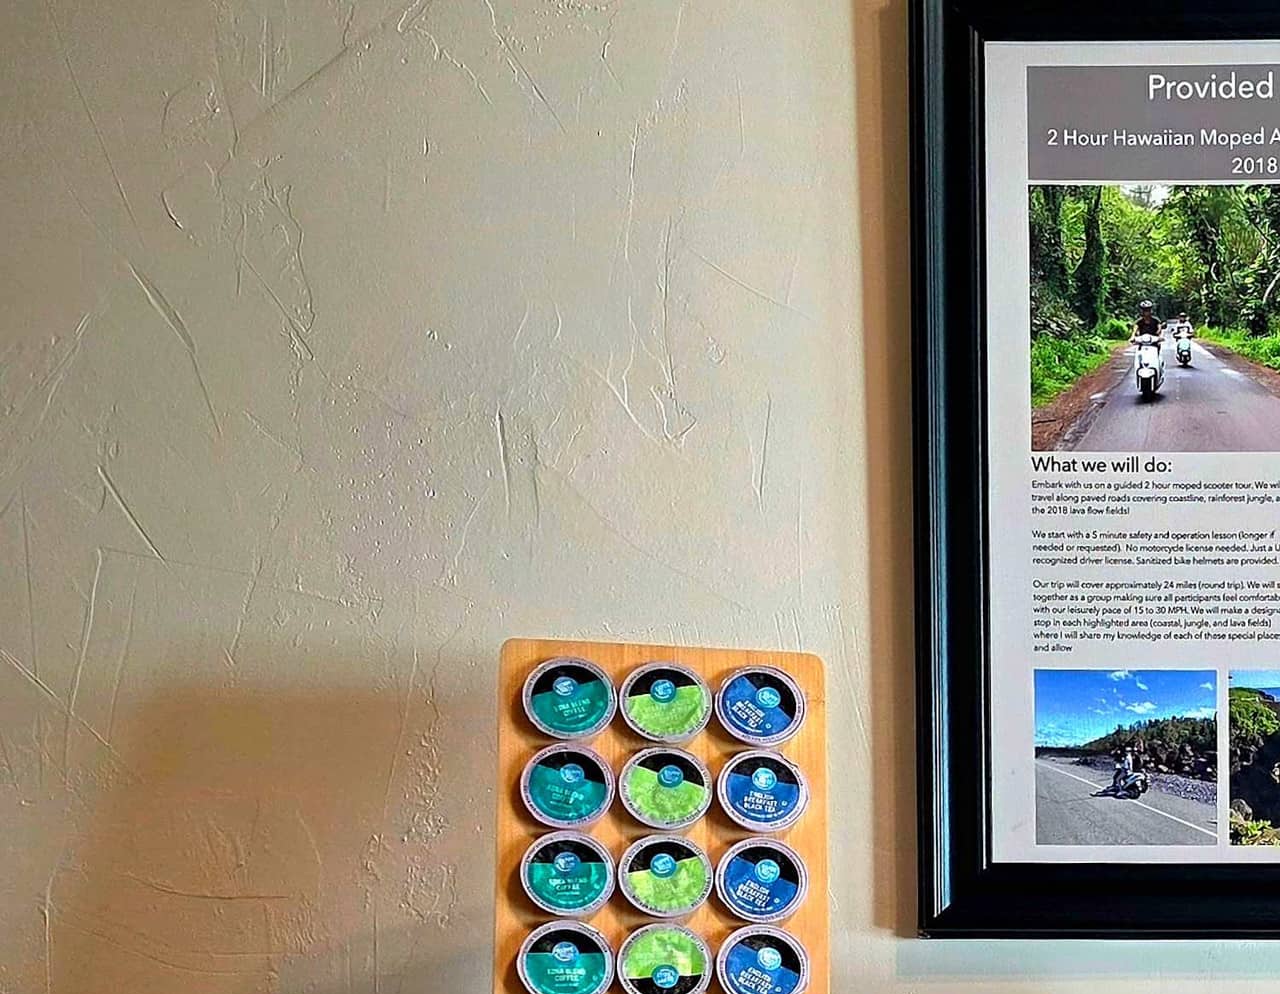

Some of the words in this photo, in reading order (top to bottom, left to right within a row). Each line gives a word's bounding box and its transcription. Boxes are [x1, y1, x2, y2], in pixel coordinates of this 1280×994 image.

[1148, 71, 1273, 100] Provided
[1047, 128, 1058, 146] 2
[1063, 128, 1109, 147] Hour
[1113, 128, 1195, 147] Hawaiian
[1200, 126, 1265, 151] Moped
[1231, 156, 1278, 175] 2018
[1030, 455, 1078, 473] What
[1081, 460, 1107, 473] we
[1110, 455, 1139, 473] will
[1143, 455, 1172, 473] do:
[1031, 480, 1063, 489] Embark
[1064, 480, 1082, 489] with
[1113, 480, 1143, 491] guided
[1144, 480, 1150, 489] 2
[1151, 480, 1171, 490] hour
[1172, 480, 1202, 491] moped
[1203, 482, 1233, 490] scooter
[1235, 482, 1254, 490] tour.
[1254, 481, 1268, 489] We
[1031, 492, 1054, 502] travel
[1055, 493, 1079, 504] along
[1080, 493, 1106, 504] paved
[1107, 493, 1131, 502] roads
[1132, 494, 1167, 504] covering
[1168, 494, 1206, 503] coastline,
[1208, 493, 1245, 503] rainforest
[1246, 493, 1274, 504] jungle,
[1031, 506, 1045, 514] the
[1047, 505, 1068, 515] 2018
[1069, 506, 1086, 515] lava
[1087, 506, 1104, 515] flow
[1105, 506, 1130, 515] fields!
[1033, 643, 1049, 652] and
[1051, 643, 1073, 652] allow
